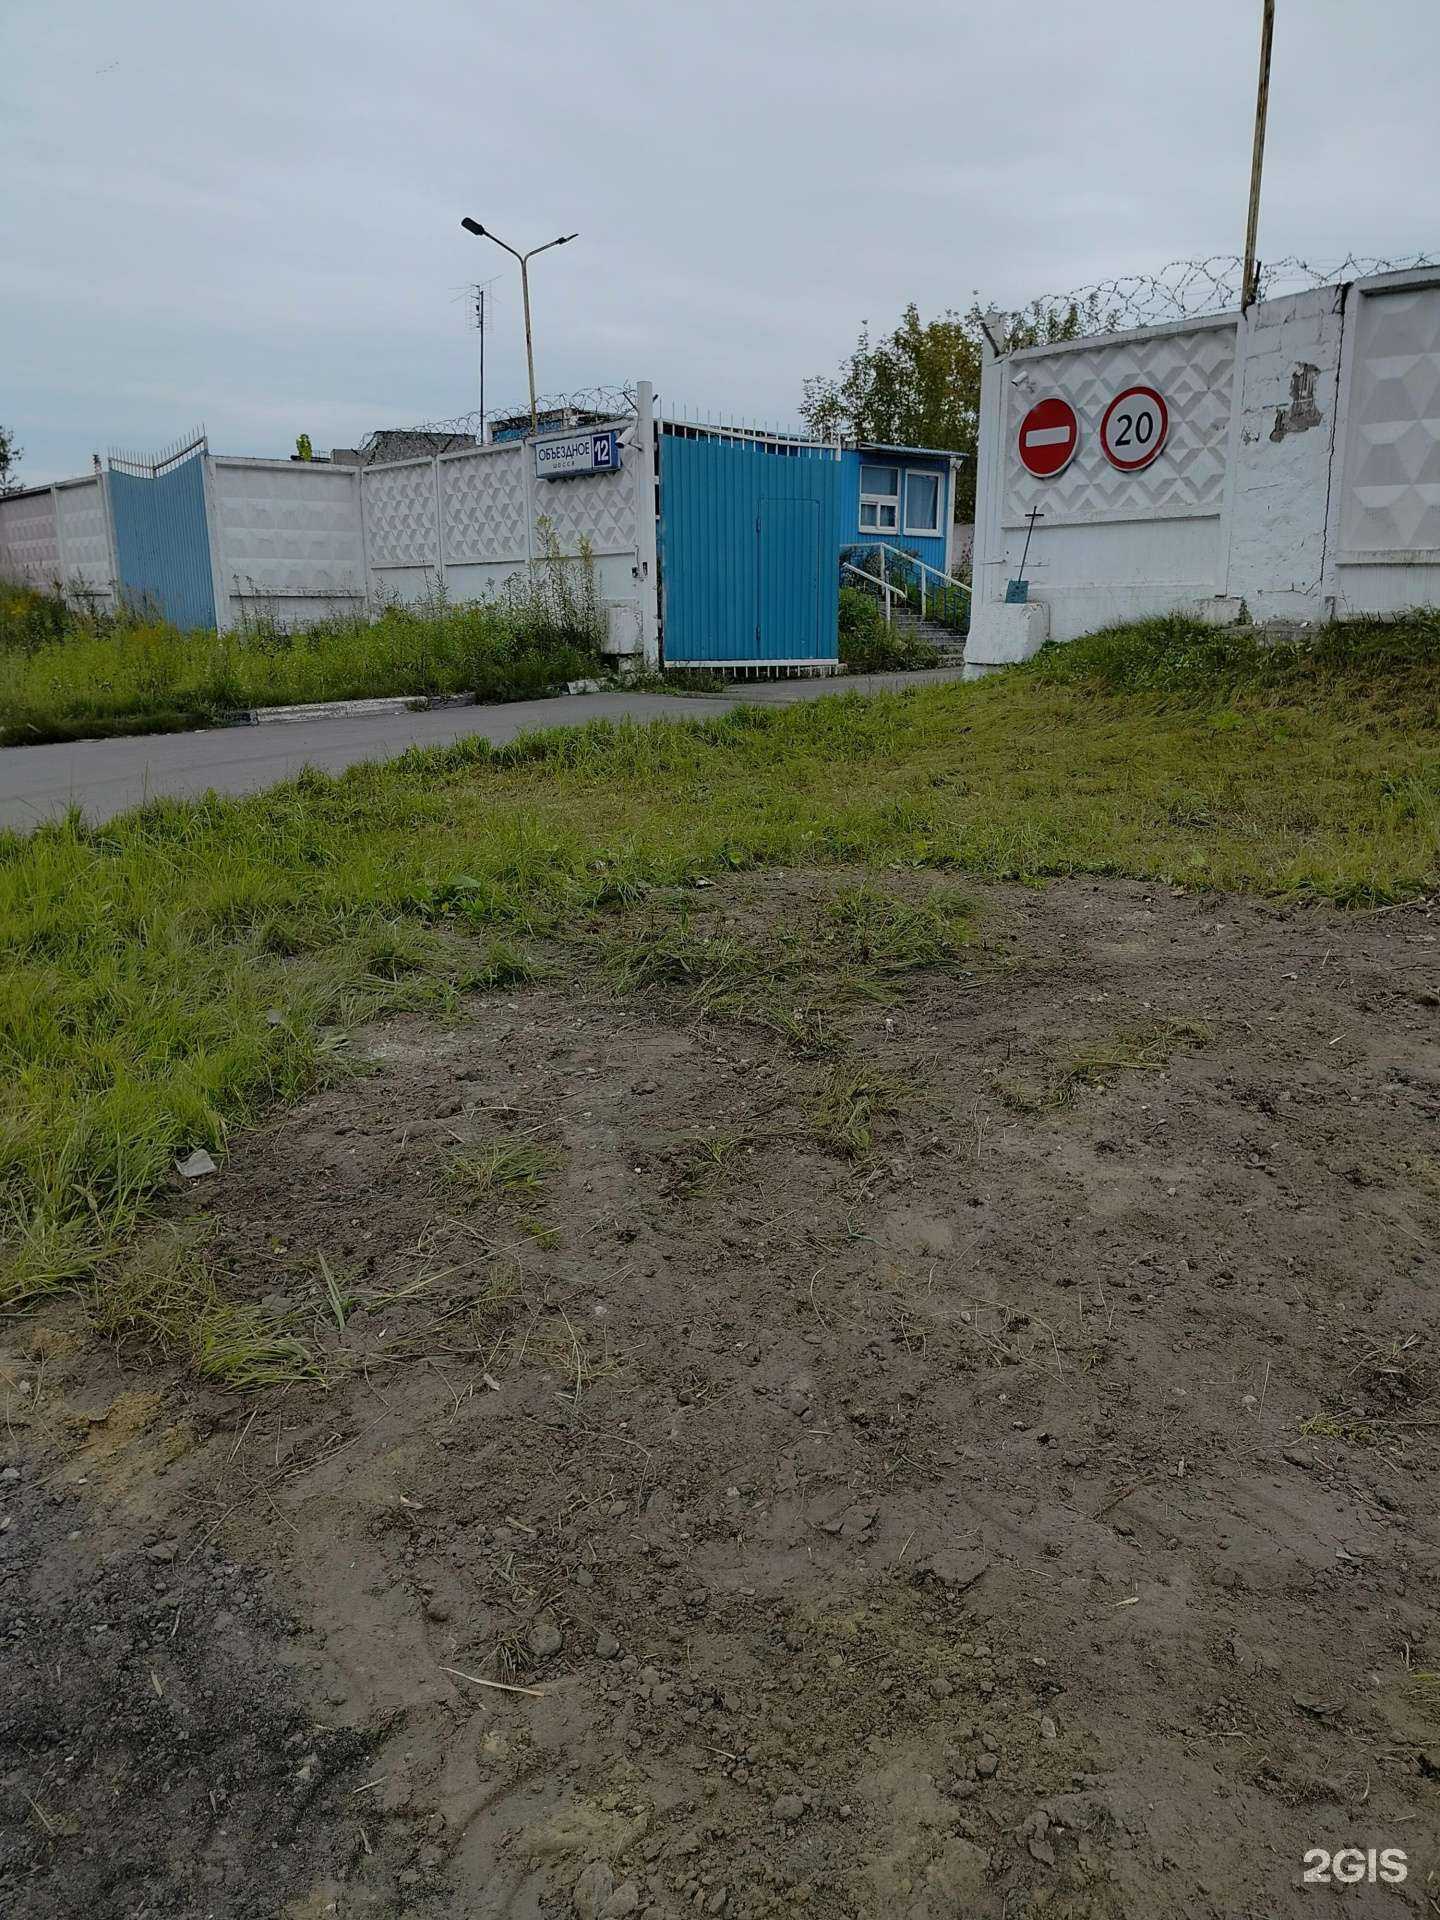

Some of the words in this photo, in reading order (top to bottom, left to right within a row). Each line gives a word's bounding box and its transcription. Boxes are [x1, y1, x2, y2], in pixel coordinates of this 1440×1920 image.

[1115, 411, 1153, 446] 20
[538, 442, 590, 461] ОБЪЕЗДНОЕ
[594, 439, 609, 461] 12
